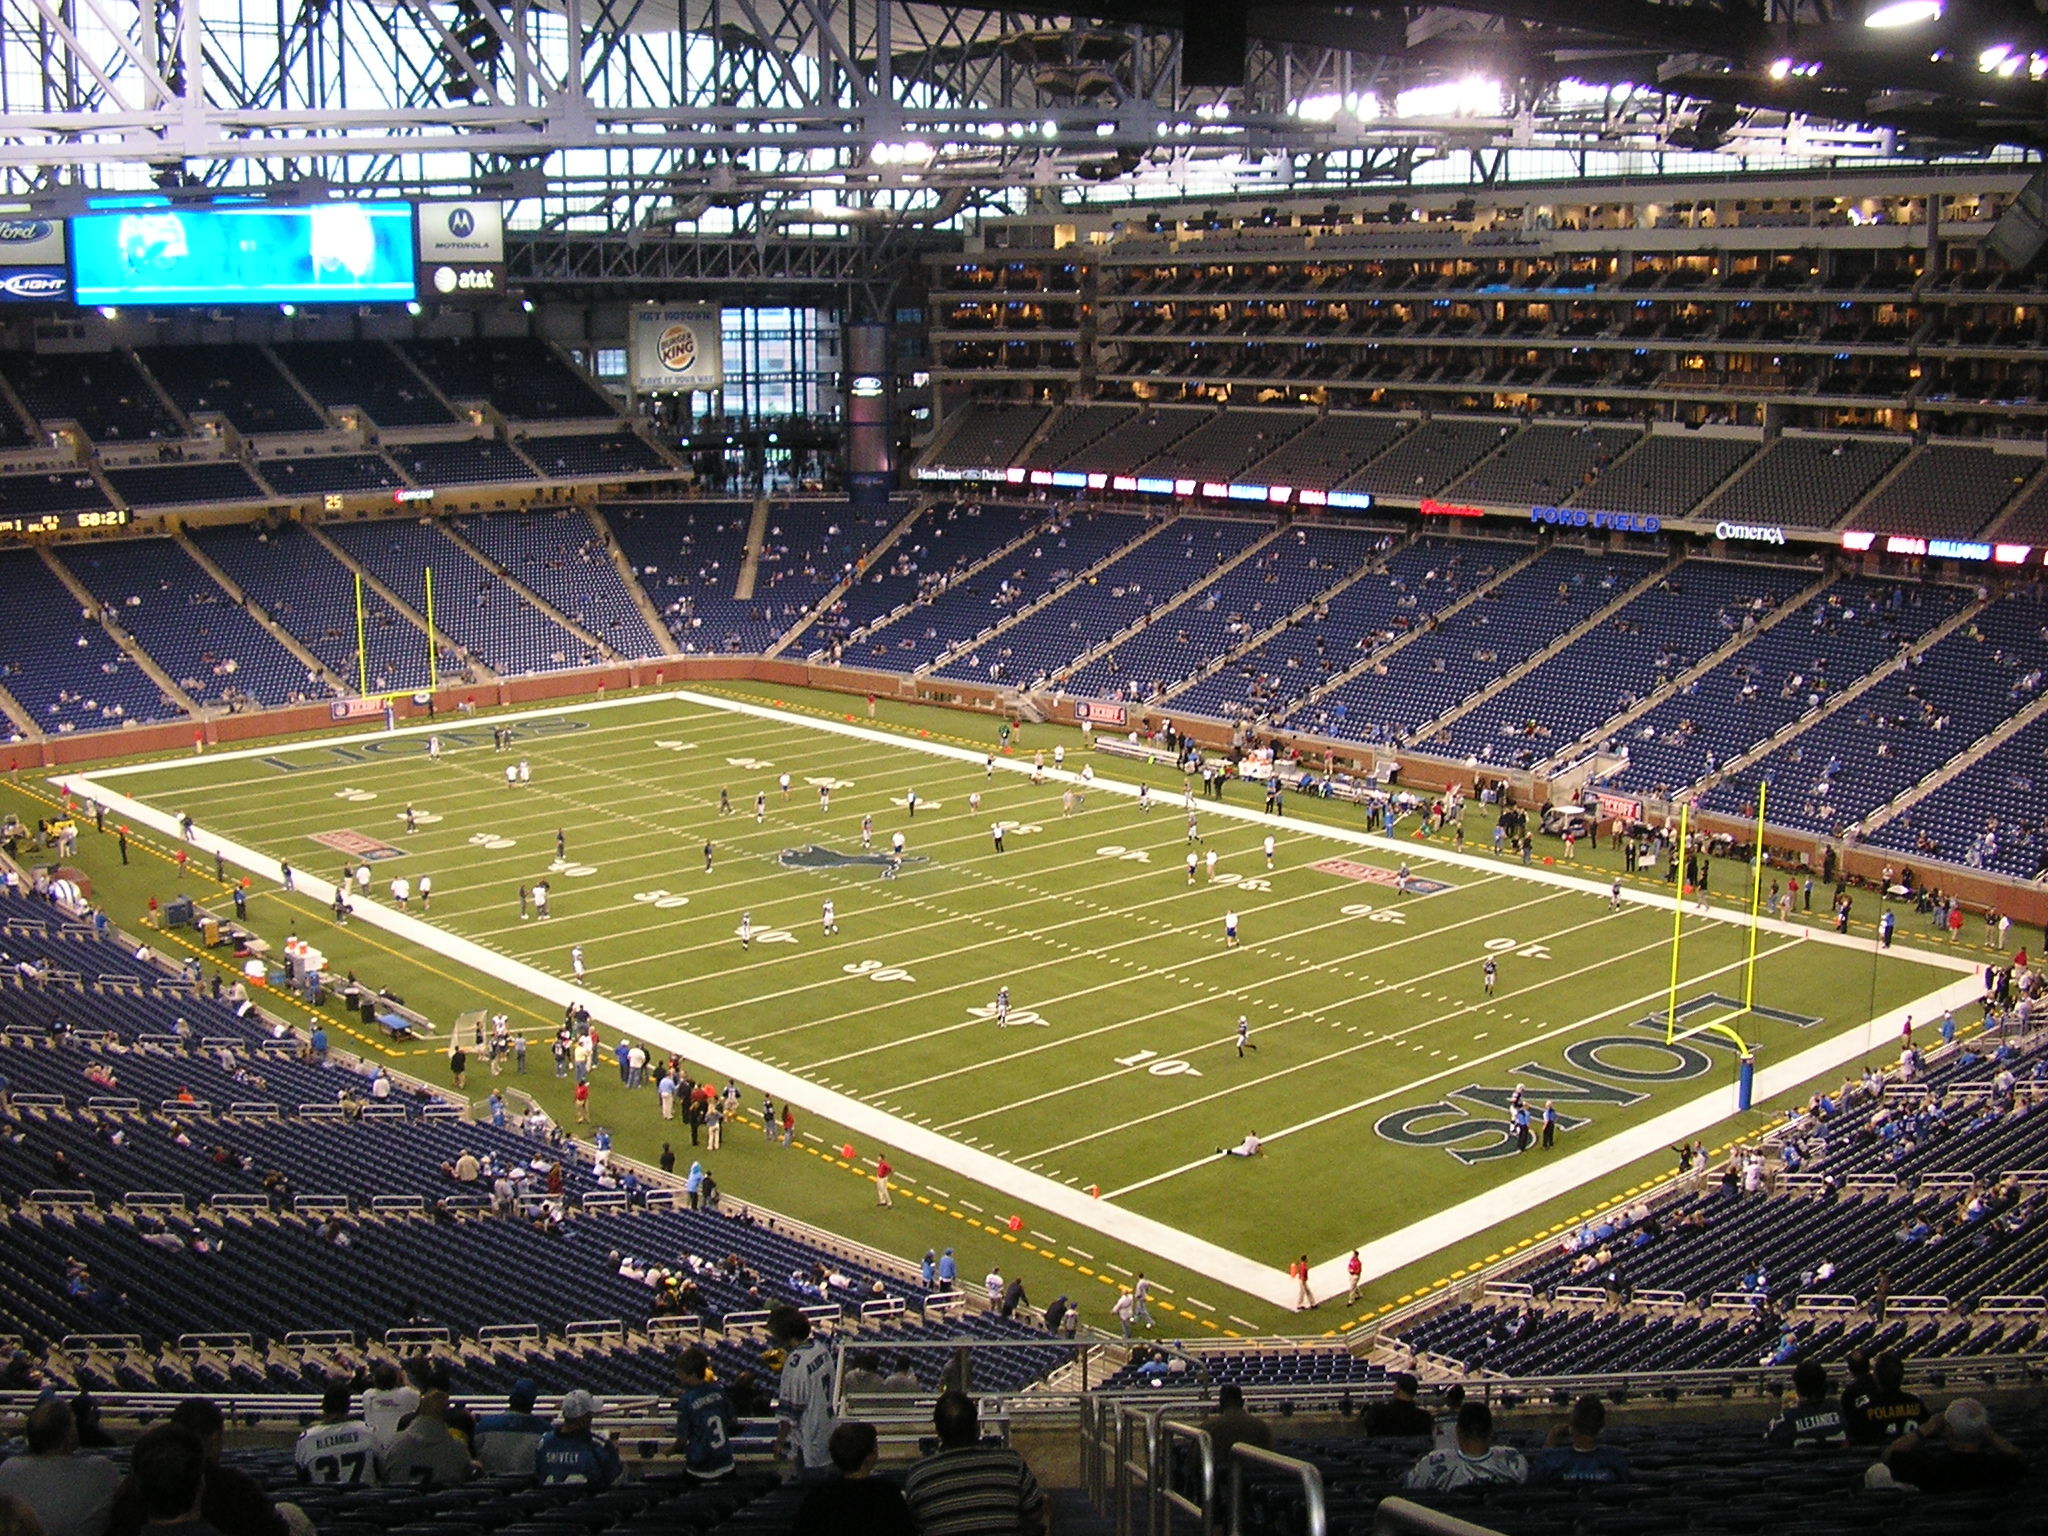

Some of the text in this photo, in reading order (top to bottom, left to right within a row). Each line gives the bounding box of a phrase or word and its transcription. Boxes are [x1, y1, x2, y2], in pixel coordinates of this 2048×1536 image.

[14, 279, 66, 290] LIGHT
[459, 269, 494, 289] at&t
[662, 341, 694, 363] KING
[938, 468, 962, 481] Detroit
[326, 494, 341, 510] 25
[78, 511, 125, 527] 58:21
[1531, 506, 1661, 533] FORD FIELD
[262, 717, 590, 772] LIONS
[633, 890, 689, 908] 50
[842, 960, 908, 981] 30
[1114, 1049, 1191, 1076] 10
[1373, 992, 1825, 1165] LIONS
[1794, 1411, 1841, 1431] ALEXANDER
[316, 1430, 359, 1449] ALEXANDER
[707, 1415, 726, 1449] 3
[315, 1451, 366, 1481] 37
